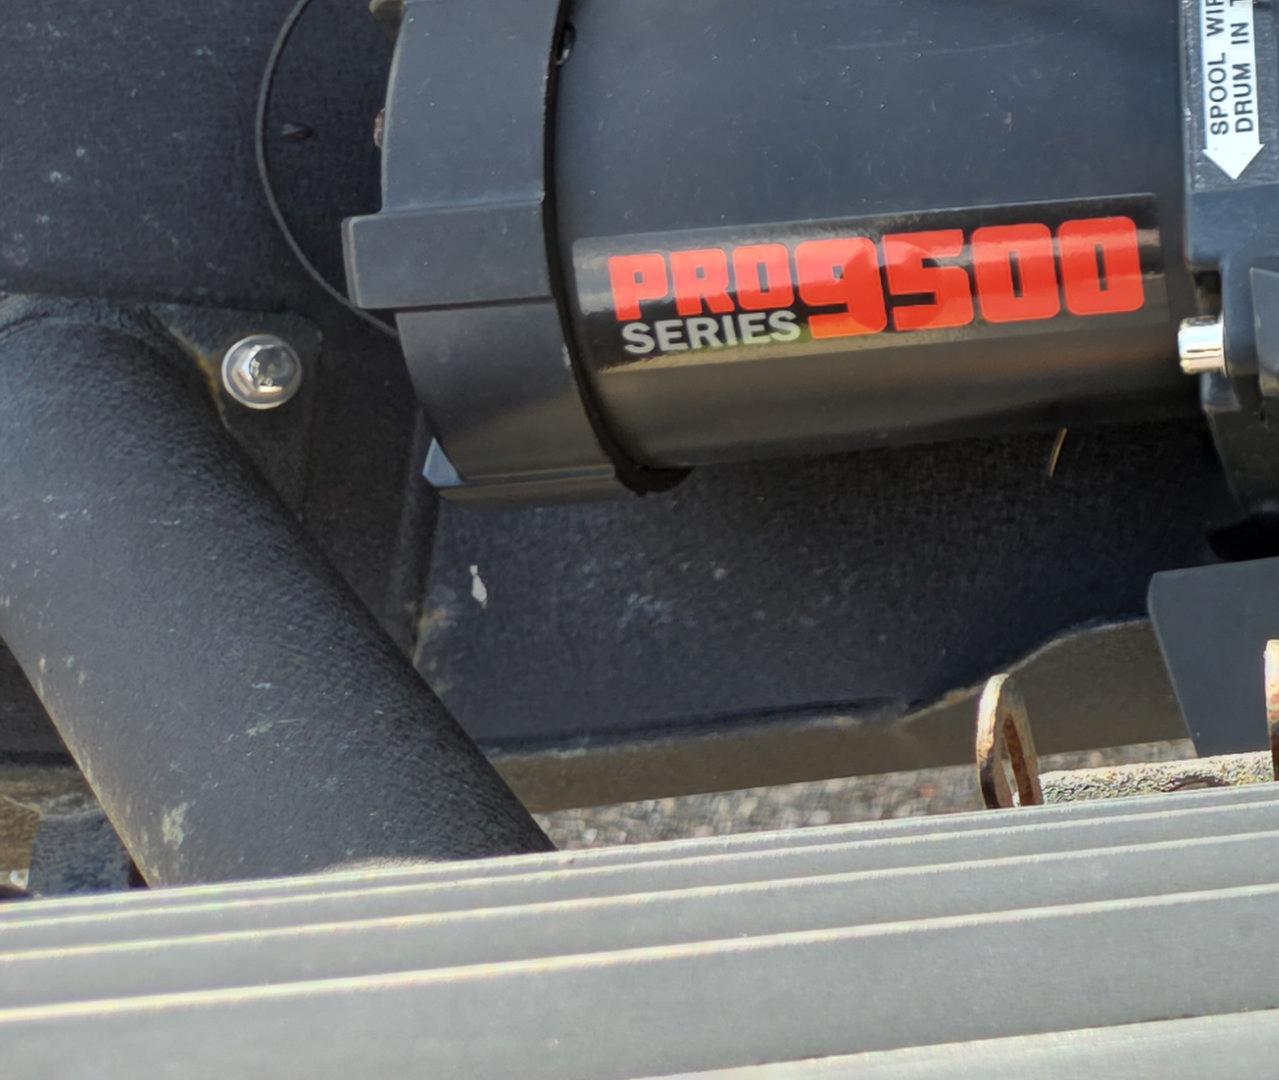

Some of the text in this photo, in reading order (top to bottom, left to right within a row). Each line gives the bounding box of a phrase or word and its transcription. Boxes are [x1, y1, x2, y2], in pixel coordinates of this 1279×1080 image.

[1230, 22, 1250, 45] IN
[1209, 51, 1228, 135] SPOOL
[1232, 62, 1253, 133] DRUM
[608, 216, 1145, 339] PRO 9500
[621, 309, 801, 356] SERIES
